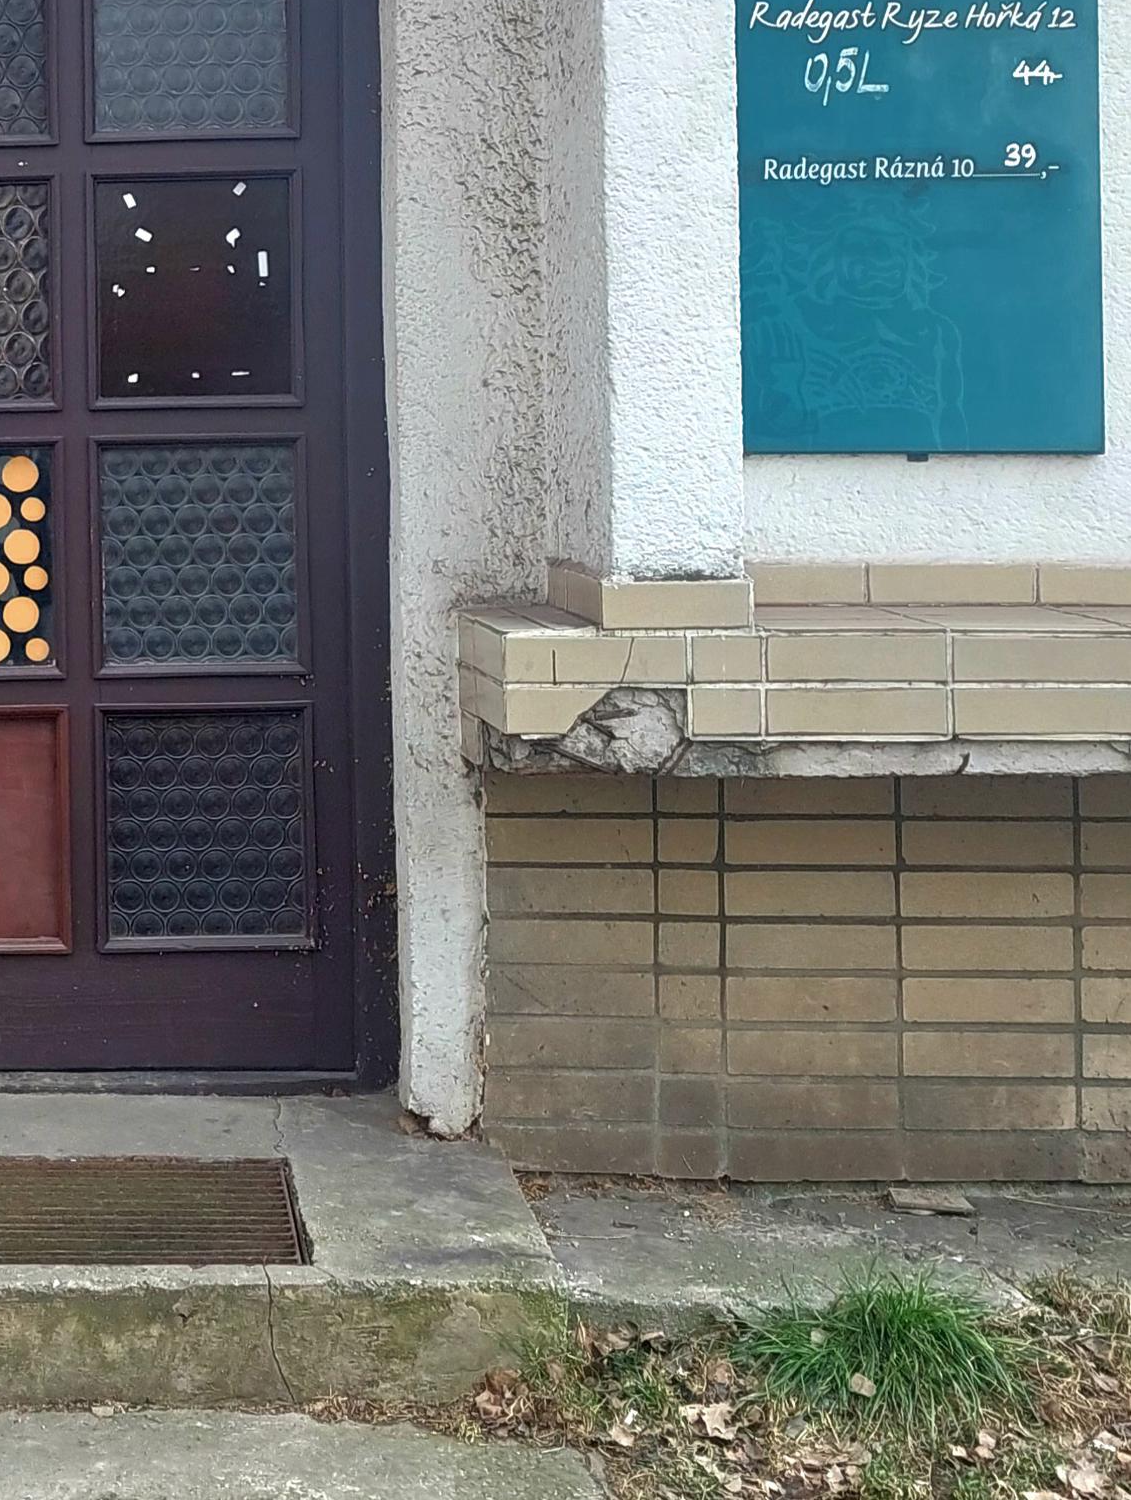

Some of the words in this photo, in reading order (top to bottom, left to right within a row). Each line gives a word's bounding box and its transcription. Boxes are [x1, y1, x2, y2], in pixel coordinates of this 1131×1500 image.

[881, 1, 958, 45] Ryze
[965, 1, 1047, 31] Hořká
[1048, 7, 1076, 28] 12
[763, 157, 867, 185] Radegast
[875, 156, 945, 180] Rázná
[951, 159, 975, 178] 10
